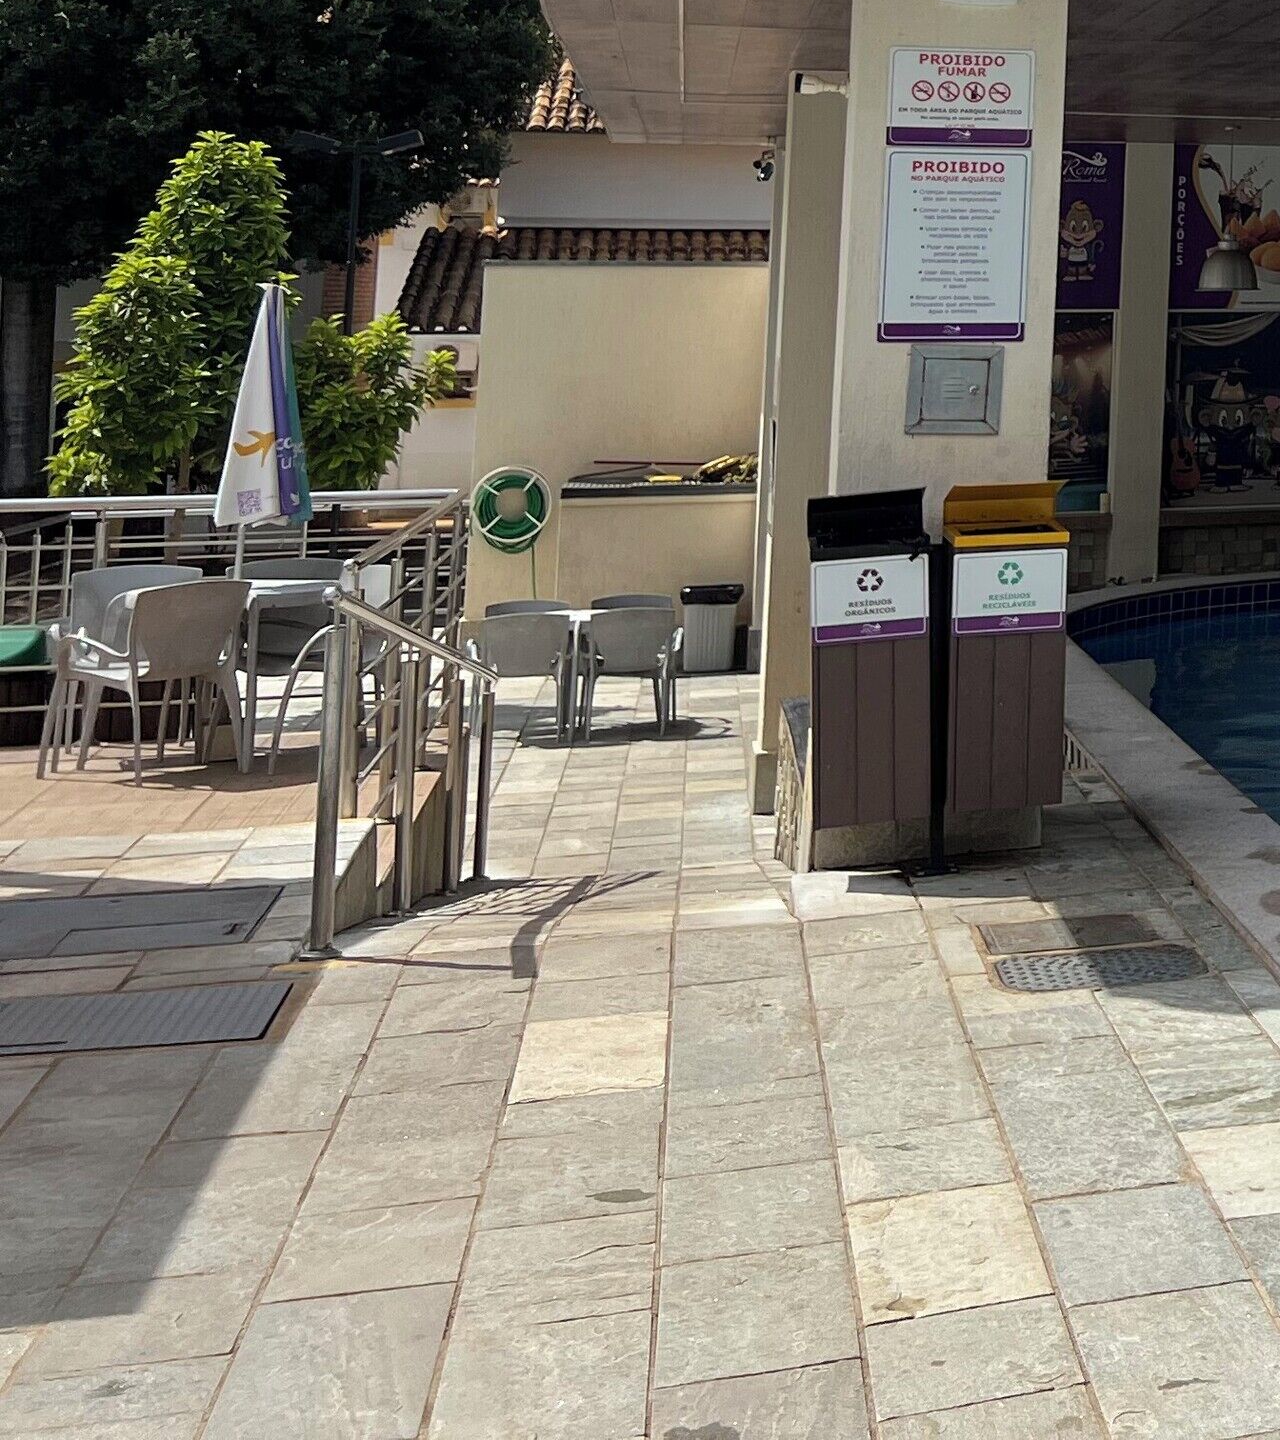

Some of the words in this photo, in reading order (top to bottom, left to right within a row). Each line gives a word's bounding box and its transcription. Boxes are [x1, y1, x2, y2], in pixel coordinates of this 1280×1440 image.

[919, 53, 1005, 67] PROIBIDO
[938, 66, 987, 77] FUMAR
[912, 160, 1005, 174] PROIBIDO
[926, 175, 959, 183] PARQUE
[961, 175, 1005, 183] AQUÁTICO
[988, 592, 1032, 601] RESÍDUOS
[848, 598, 893, 608] RESÍDUOS
[844, 606, 897, 617] ORGÂNICOS
